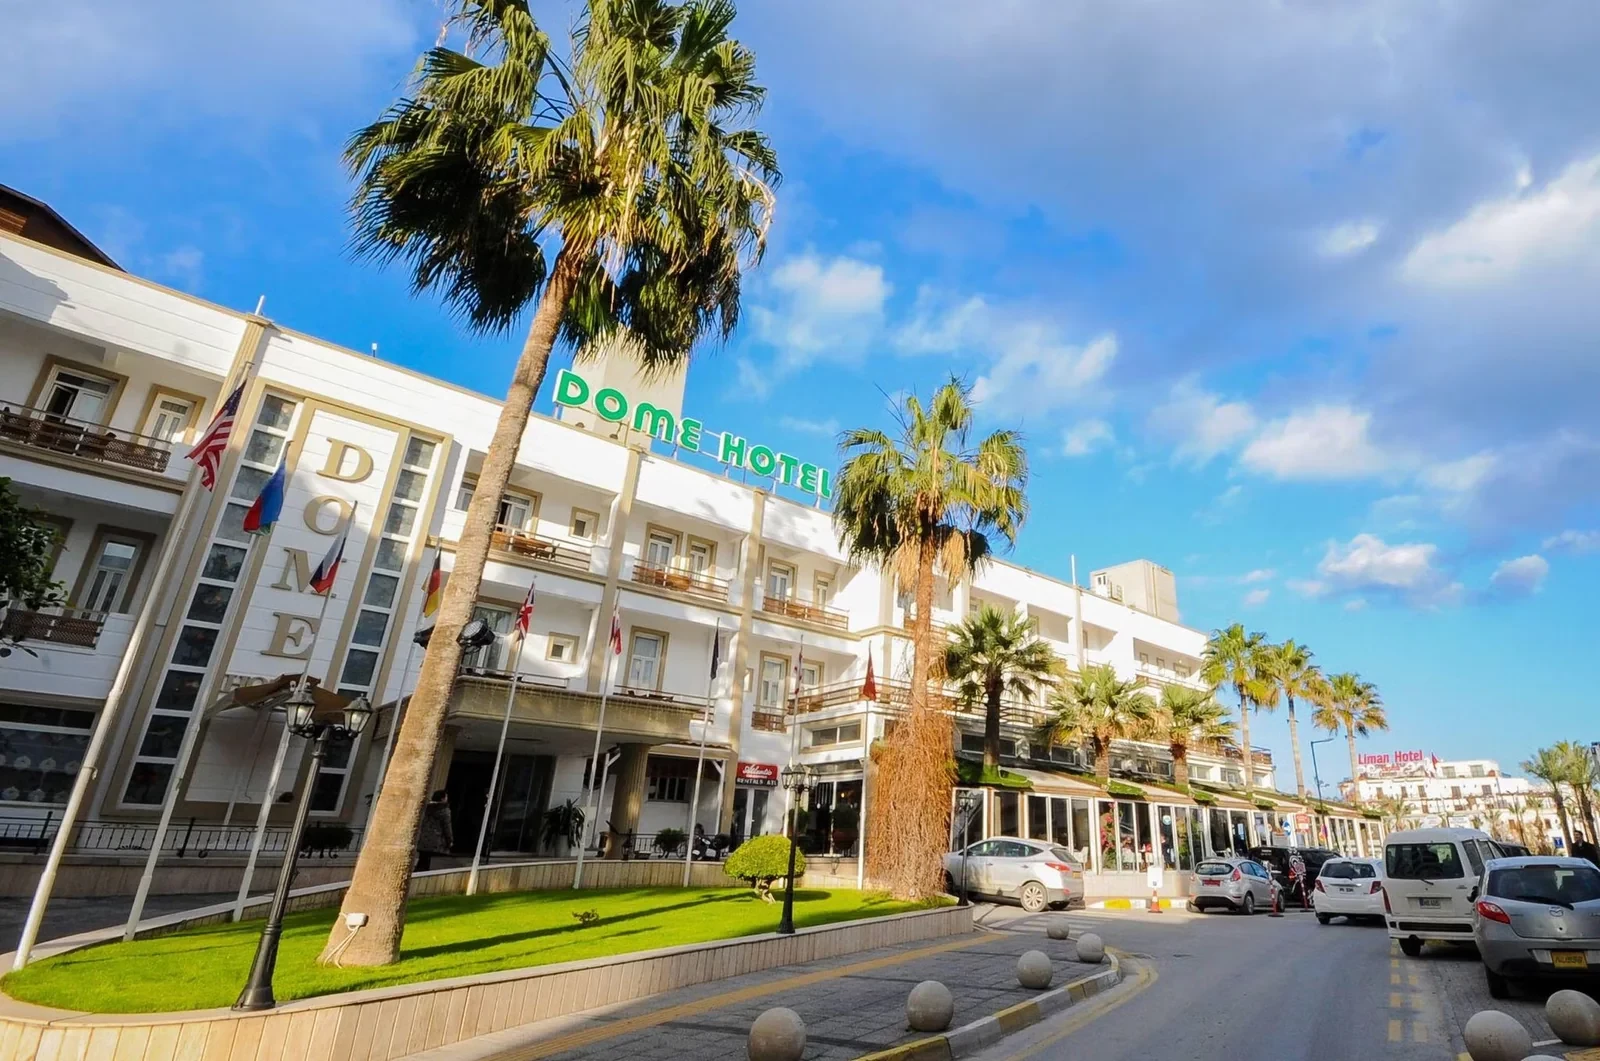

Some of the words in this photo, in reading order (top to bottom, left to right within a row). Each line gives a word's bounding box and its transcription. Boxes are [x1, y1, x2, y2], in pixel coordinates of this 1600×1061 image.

[552, 368, 702, 452] DOME
[717, 431, 832, 499] HOTEL
[259, 436, 374, 661] DOME
[1358, 754, 1389, 765] Liman
[1395, 750, 1422, 762] Hotel
